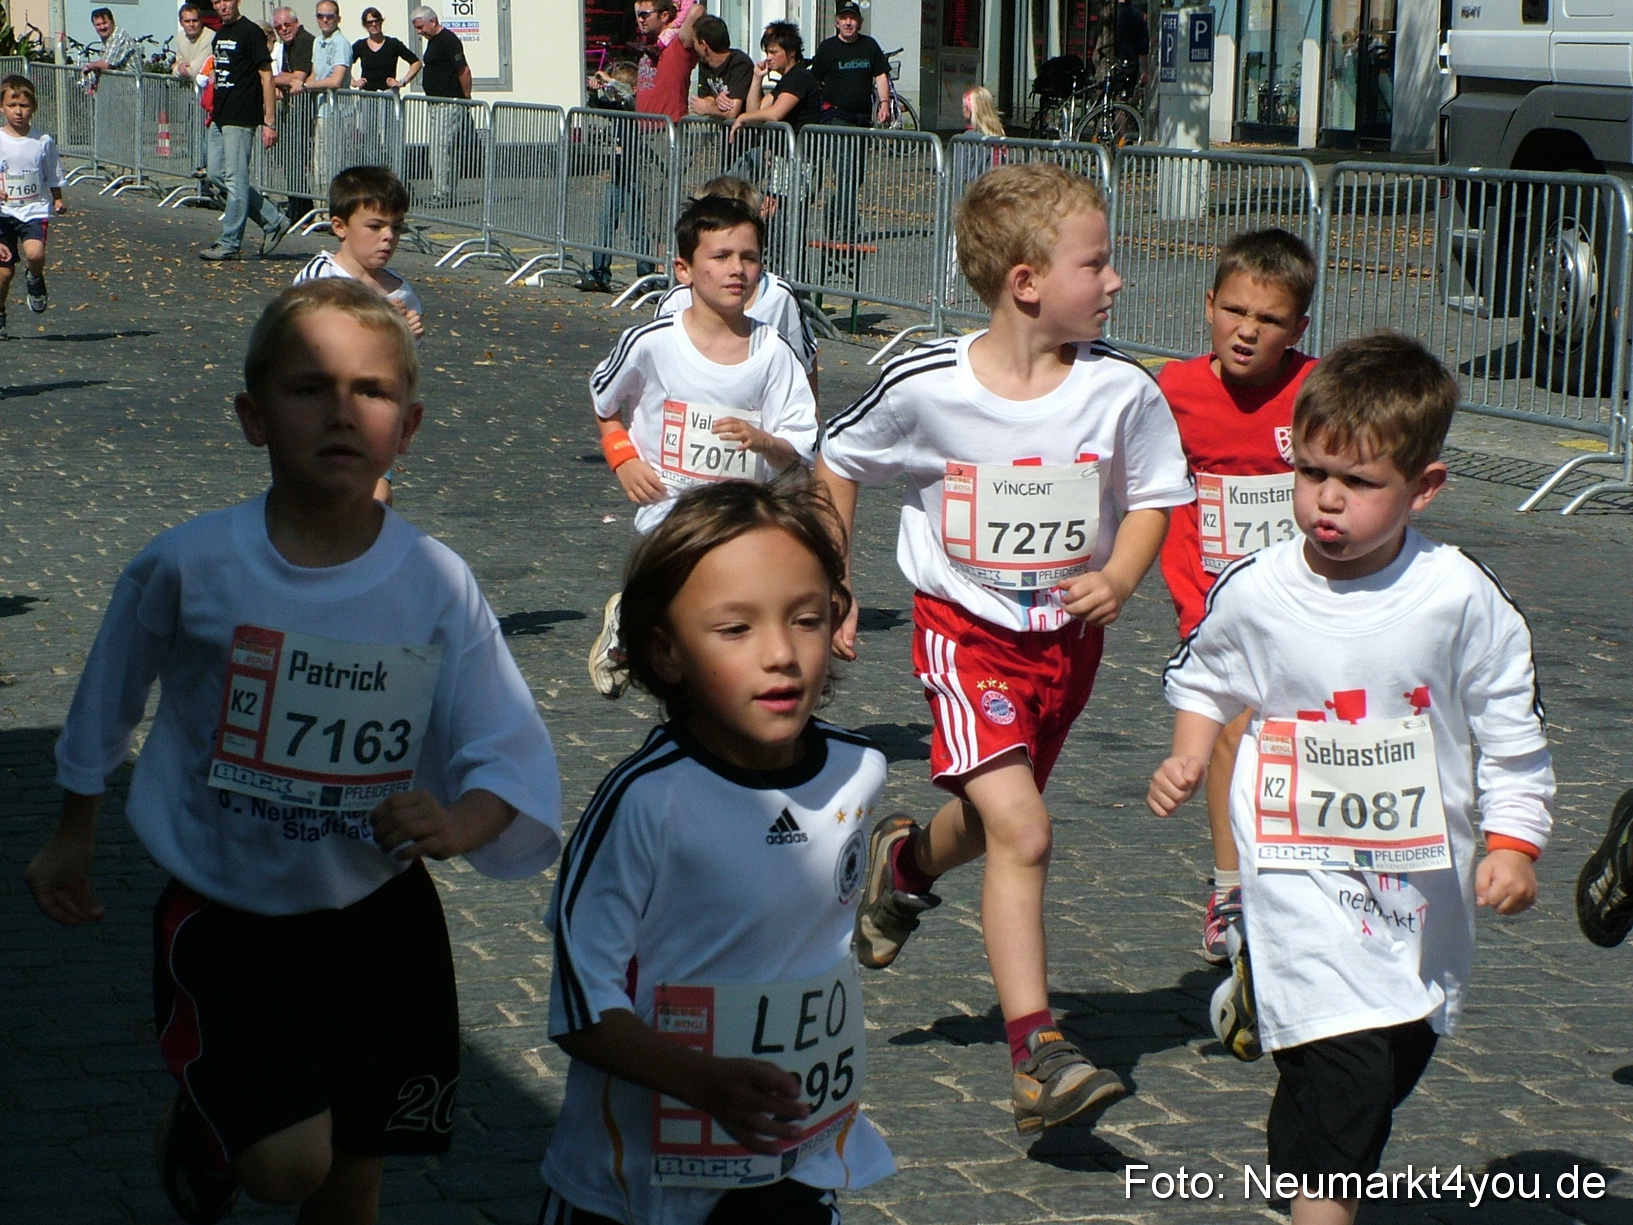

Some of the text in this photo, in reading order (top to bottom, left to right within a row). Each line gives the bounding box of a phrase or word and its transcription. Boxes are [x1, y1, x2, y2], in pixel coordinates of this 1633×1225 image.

[451, 3, 473, 15] TOI
[1163, 18, 1177, 30] HIER
[1195, 20, 1207, 42] P
[1166, 33, 1174, 63] P
[838, 59, 870, 70] Leben
[8, 184, 37, 195] 7160
[692, 412, 714, 430] Val
[665, 432, 677, 446] K2
[690, 443, 747, 473] 7071
[1203, 513, 1217, 528] K2
[988, 519, 1086, 555] 7275
[1234, 519, 1296, 548] 713
[288, 650, 388, 691] Patrick
[231, 688, 258, 715] K2
[286, 711, 411, 765] 7163
[1305, 736, 1415, 767] Sebastian
[213, 764, 410, 799] BOCK PFLEIDERER
[1263, 777, 1286, 798] K2
[1311, 786, 1426, 831] 7087
[765, 831, 808, 845] adidas
[1259, 845, 1445, 862] BOCK PFLEIDERER
[752, 979, 846, 1054] LEO
[788, 1046, 854, 1115] 95
[655, 1157, 753, 1177] BOCK
